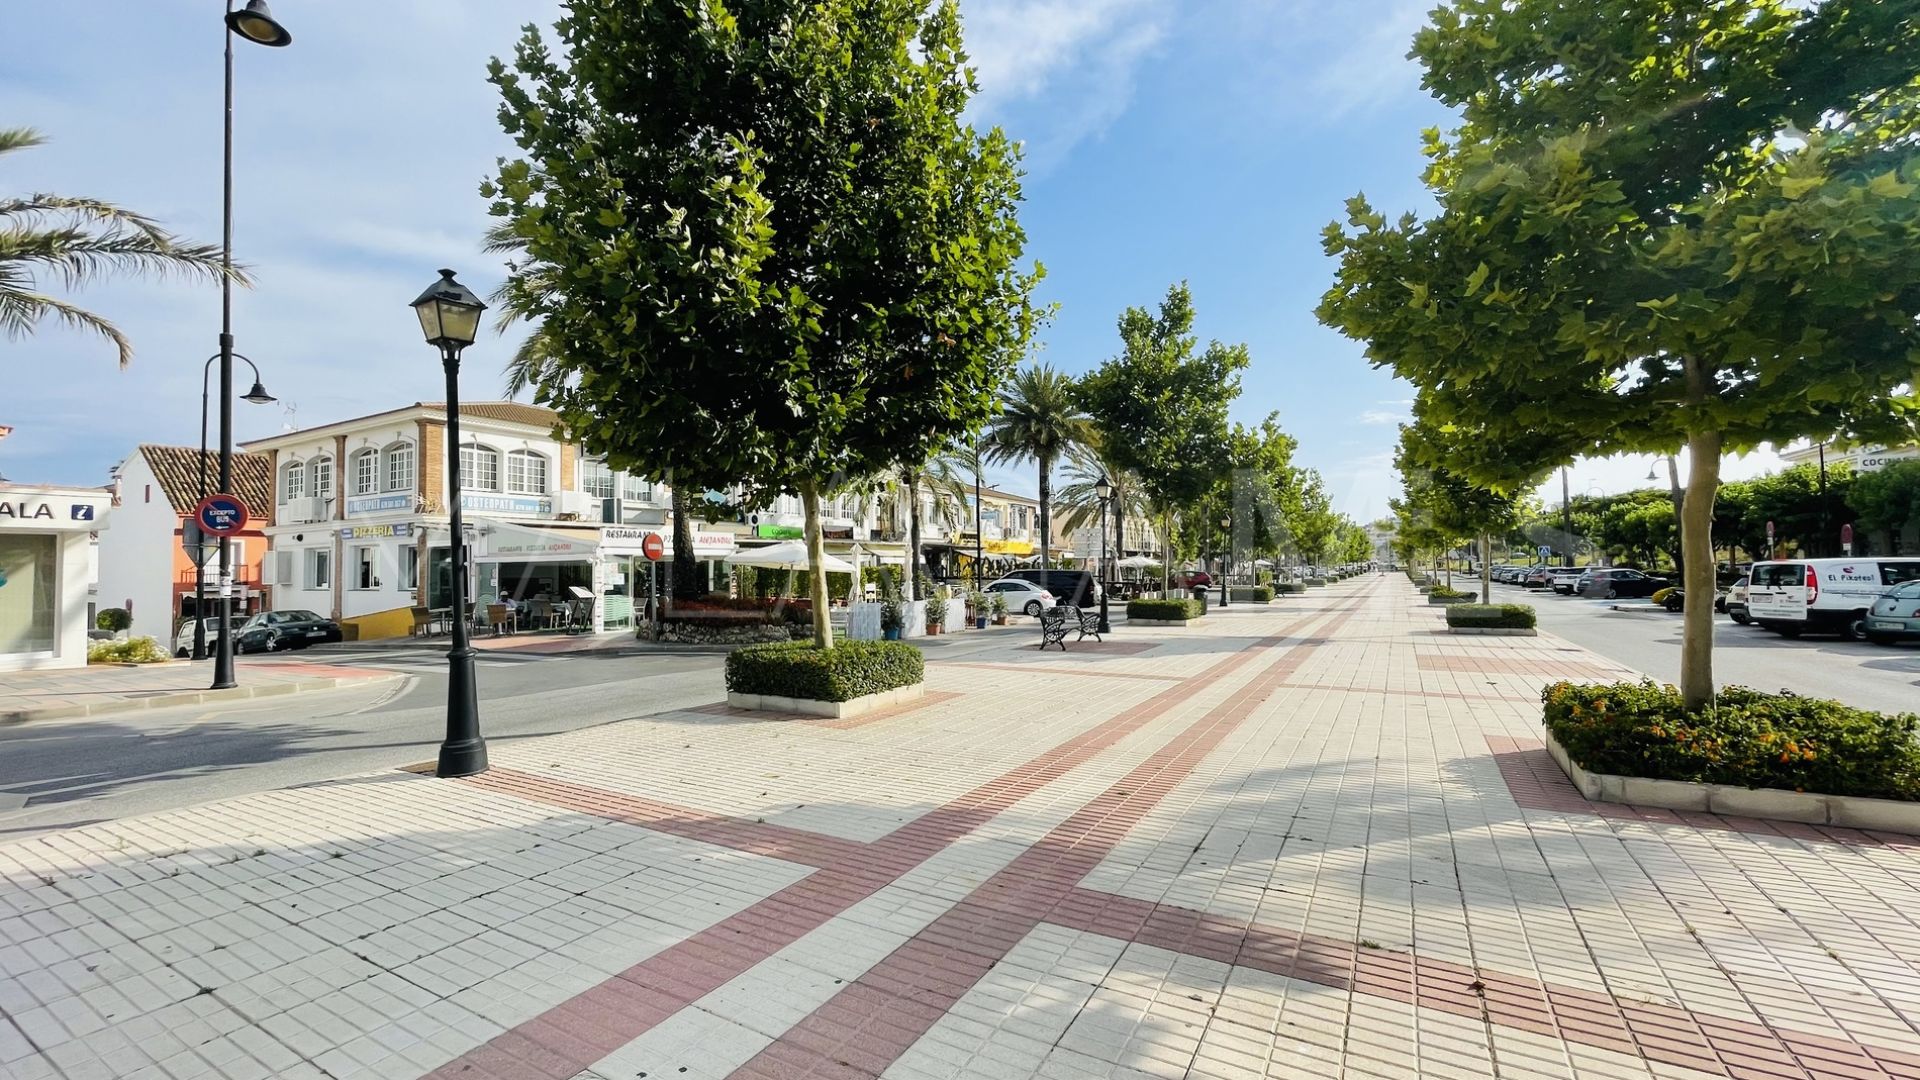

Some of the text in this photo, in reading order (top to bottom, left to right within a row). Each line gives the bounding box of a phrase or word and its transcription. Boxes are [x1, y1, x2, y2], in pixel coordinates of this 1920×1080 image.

[0, 501, 54, 519] ALA
[353, 524, 394, 538] PIZZERIA
[605, 529, 655, 541] RESTAURAN
